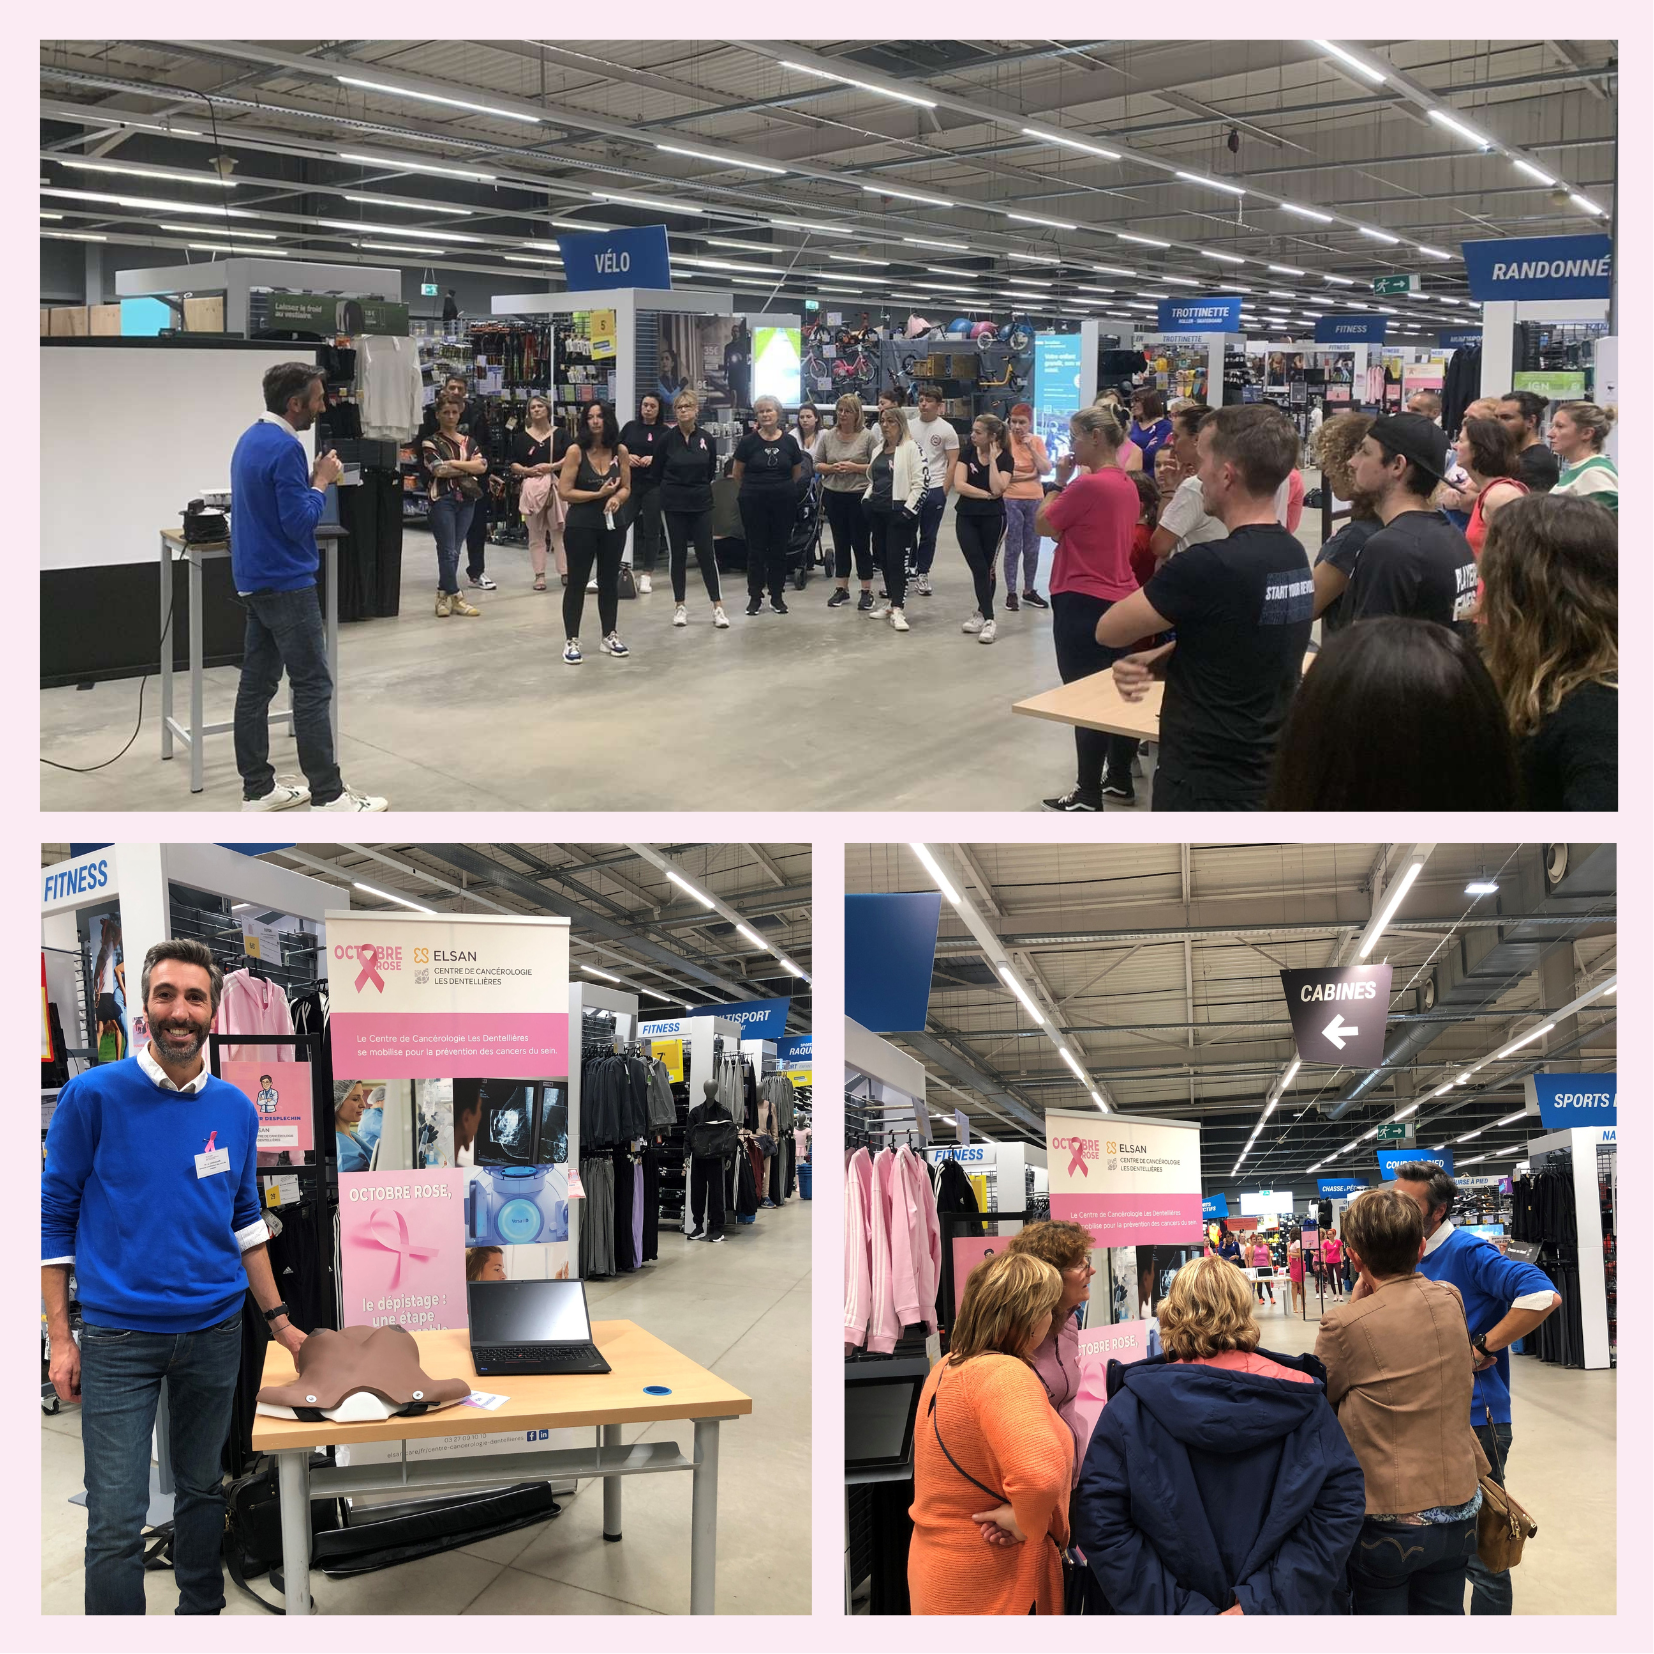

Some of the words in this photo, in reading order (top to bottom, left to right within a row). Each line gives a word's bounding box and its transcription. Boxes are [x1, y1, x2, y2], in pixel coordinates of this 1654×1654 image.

[594, 248, 631, 273] VÉLO
[1492, 254, 1611, 280] RANDONNÉ
[1172, 306, 1230, 318] TROTTINETTE
[1335, 325, 1367, 334] FITNESS
[1163, 335, 1202, 343] TROTTINETTE
[1265, 585, 1289, 601] START
[44, 859, 108, 902] FITNESS
[433, 950, 477, 962] ELSAN
[376, 960, 402, 971] ROSE
[434, 967, 464, 975] CENTRE
[465, 967, 475, 975] DE
[476, 966, 533, 976] CANCÉROLOGIE
[434, 977, 448, 985] LES
[449, 976, 502, 985] DENTELLIÈRES
[1300, 981, 1377, 1002] CABINES
[642, 1022, 681, 1034] FITNESS
[356, 1035, 367, 1043] Le
[369, 1034, 398, 1043] Centre
[399, 1034, 410, 1043] de
[412, 1034, 466, 1044] Cancérologie
[467, 1034, 481, 1042] Les
[482, 1033, 529, 1042] Dentellières
[369, 1048, 403, 1056] mobilise
[405, 1049, 425, 1058] pour
[426, 1048, 433, 1056] la
[435, 1047, 478, 1057] prévention
[479, 1047, 494, 1055] des
[495, 1047, 527, 1055] cancers
[540, 1047, 558, 1055] sein.
[1554, 1093, 1610, 1108] SPORTS
[1119, 1143, 1147, 1154] ELSAN
[934, 1149, 984, 1162] FITNESS
[1082, 1150, 1100, 1160] ROSE
[1146, 1157, 1181, 1166] CANCÉROLOGIE
[350, 1185, 411, 1202] OCTOBRE
[414, 1184, 452, 1199] ROSE,
[1070, 1211, 1078, 1219] Le
[1079, 1211, 1098, 1219] Centre
[1100, 1210, 1107, 1218] de
[1107, 1210, 1143, 1218] Cancérologie
[1153, 1209, 1181, 1217] Dentellières
[1123, 1220, 1151, 1229] prévention
[362, 1298, 374, 1312] le
[377, 1293, 440, 1312] dépistage
[372, 1315, 396, 1328] une
[399, 1310, 435, 1327] étape
[1112, 1335, 1139, 1350] ROSE,
